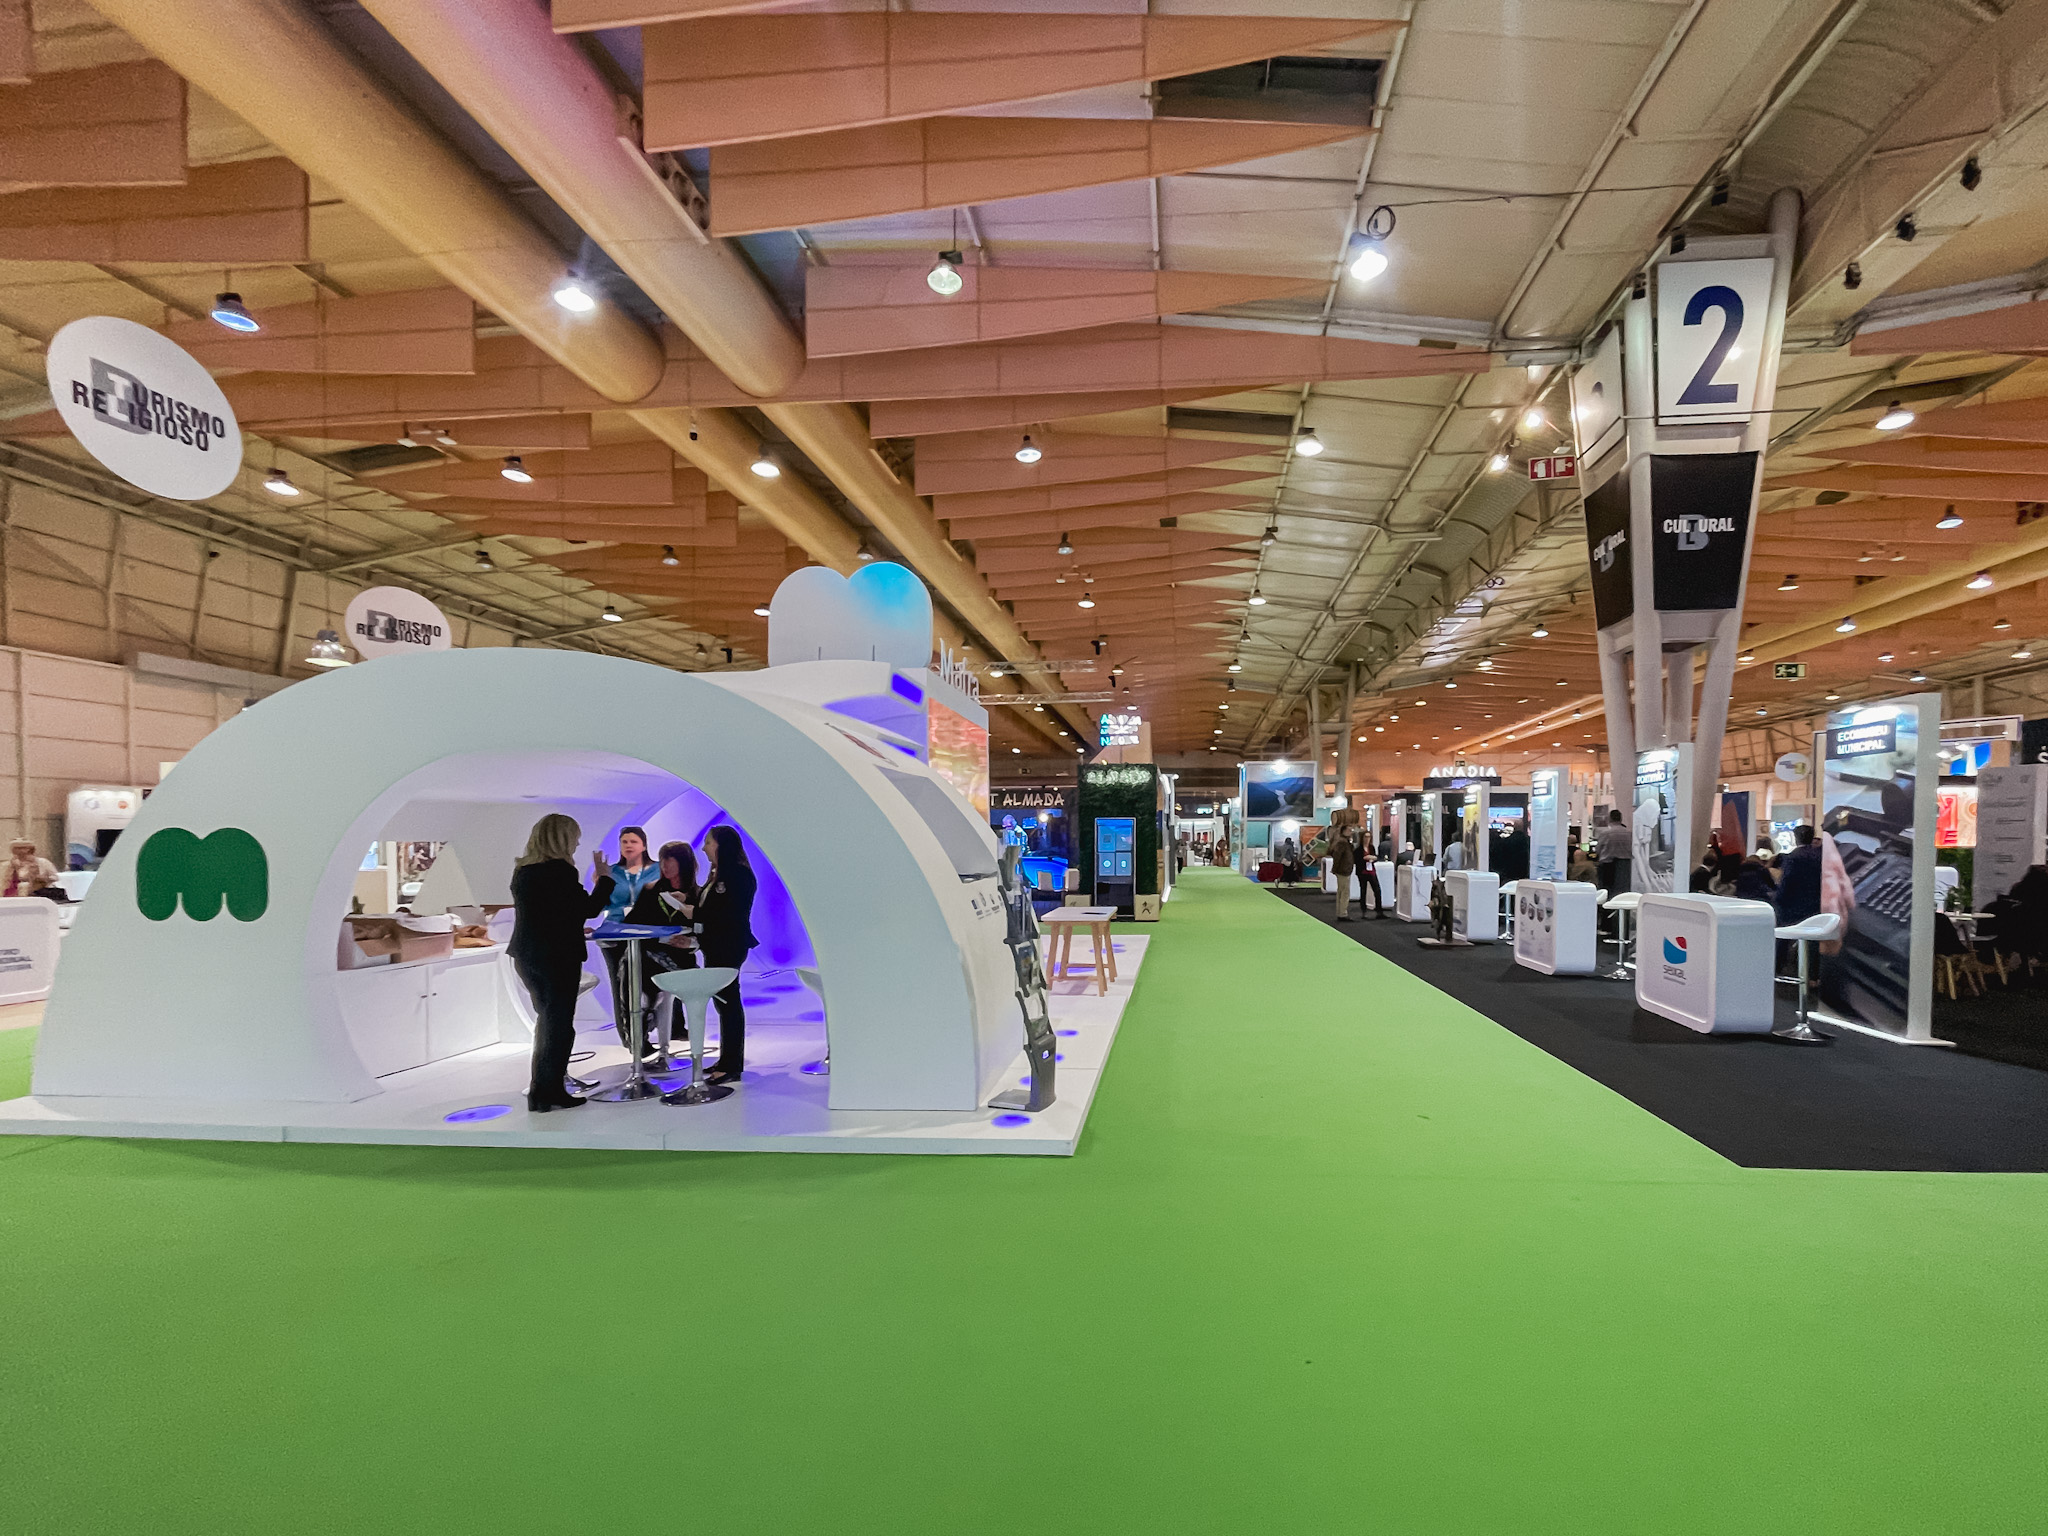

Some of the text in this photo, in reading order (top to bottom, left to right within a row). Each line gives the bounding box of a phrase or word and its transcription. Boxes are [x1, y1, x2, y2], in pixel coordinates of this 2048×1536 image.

[1676, 285, 1744, 405] 2
[72, 380, 209, 451] RELIGIOSO
[107, 372, 226, 438] TURISMO
[1663, 518, 1736, 534] CULTURAL
[356, 623, 431, 646] RELIGIOSO
[375, 615, 442, 638] TURISMO
[940, 637, 980, 700] Mafra
[1836, 739, 1886, 754] MUNICIPAL
[1429, 766, 1498, 777] ANADIA
[1002, 793, 1065, 807] ALMADA
